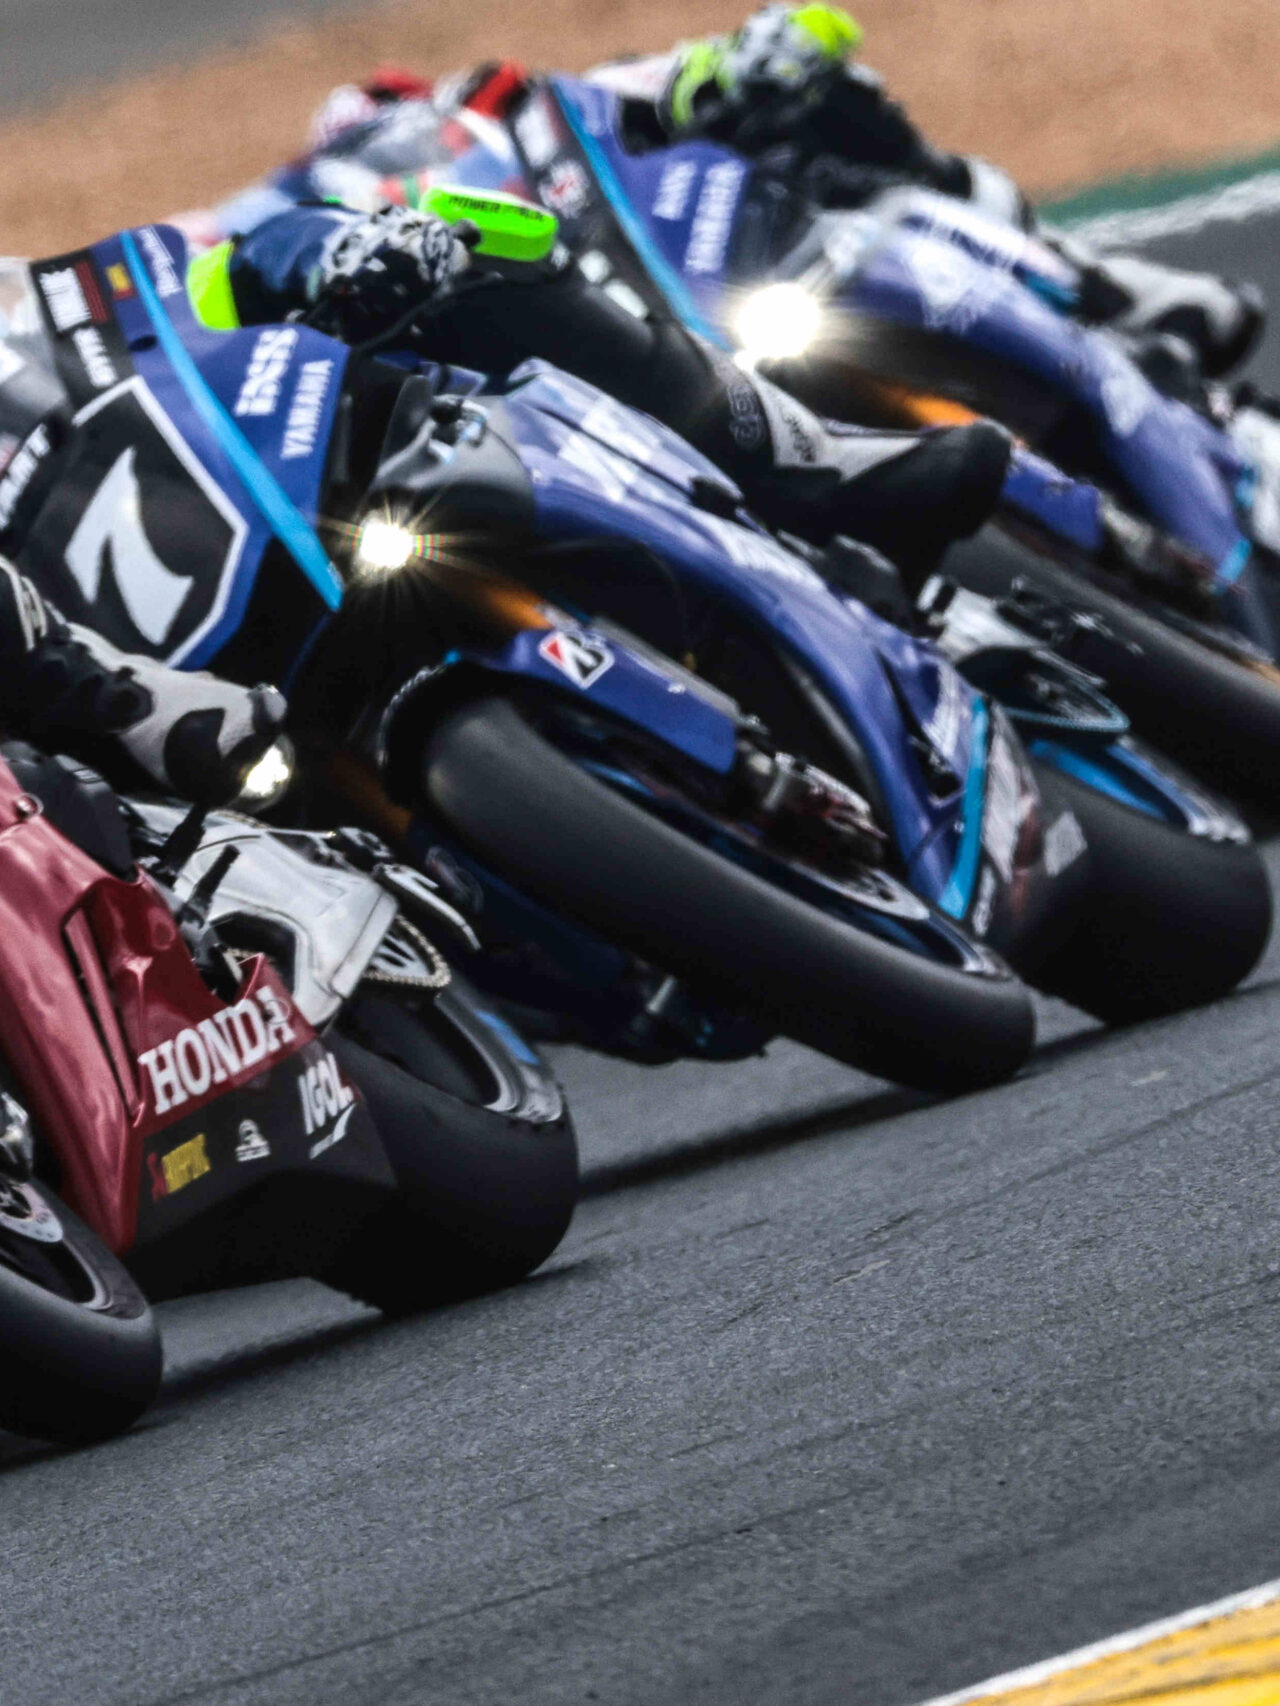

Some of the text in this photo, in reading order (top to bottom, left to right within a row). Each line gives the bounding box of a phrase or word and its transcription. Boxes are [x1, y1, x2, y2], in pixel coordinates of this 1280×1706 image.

[280, 359, 334, 460] YAMAHA
[64, 446, 195, 646] 7
[137, 985, 298, 1116] HONDA
[298, 1052, 354, 1136] IGOL
